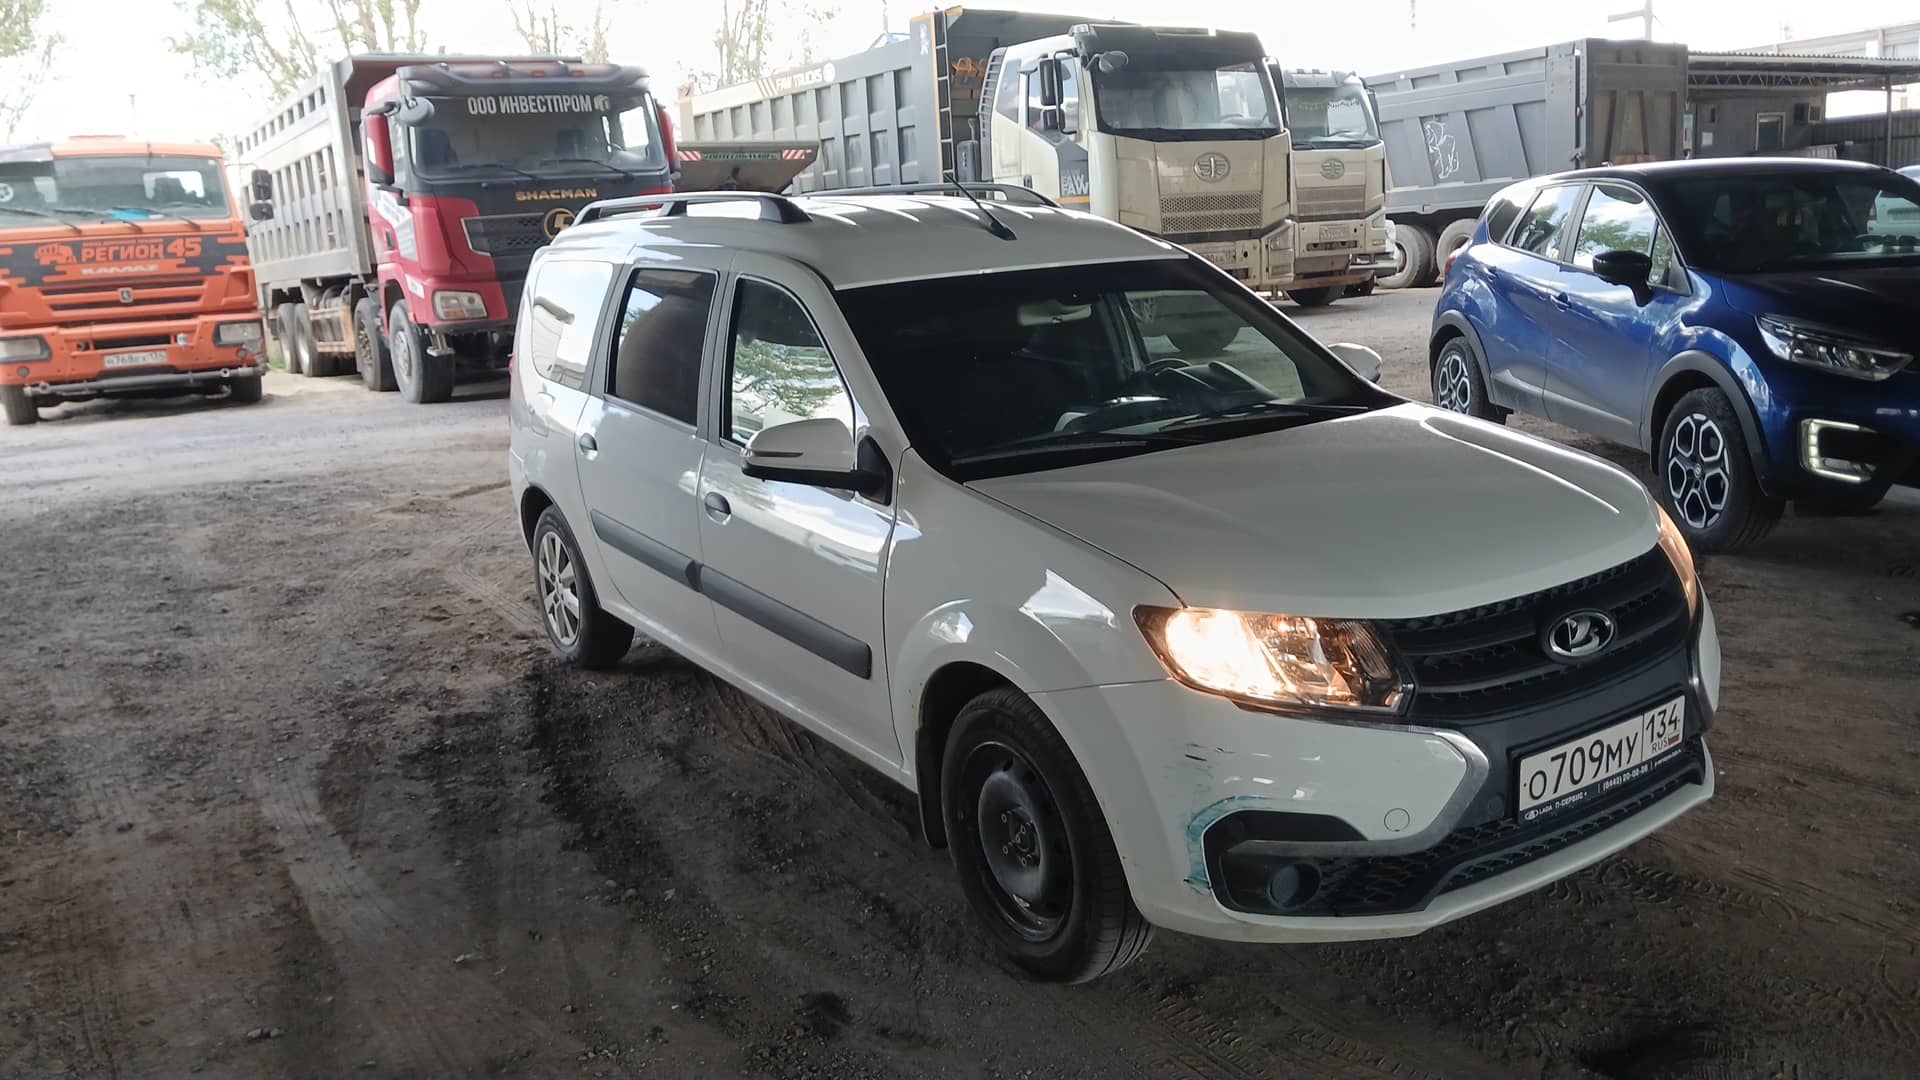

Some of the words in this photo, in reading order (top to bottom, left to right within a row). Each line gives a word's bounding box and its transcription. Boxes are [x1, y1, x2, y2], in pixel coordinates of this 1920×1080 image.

[467, 96, 497, 115] ООО
[499, 94, 593, 114] ИНВЕСТПРОМ
[515, 187, 598, 201] SHACMAN
[81, 243, 165, 262] РЕГИОН
[167, 237, 202, 257] 45
[1645, 703, 1678, 743] 134
[1651, 736, 1669, 754] RUS
